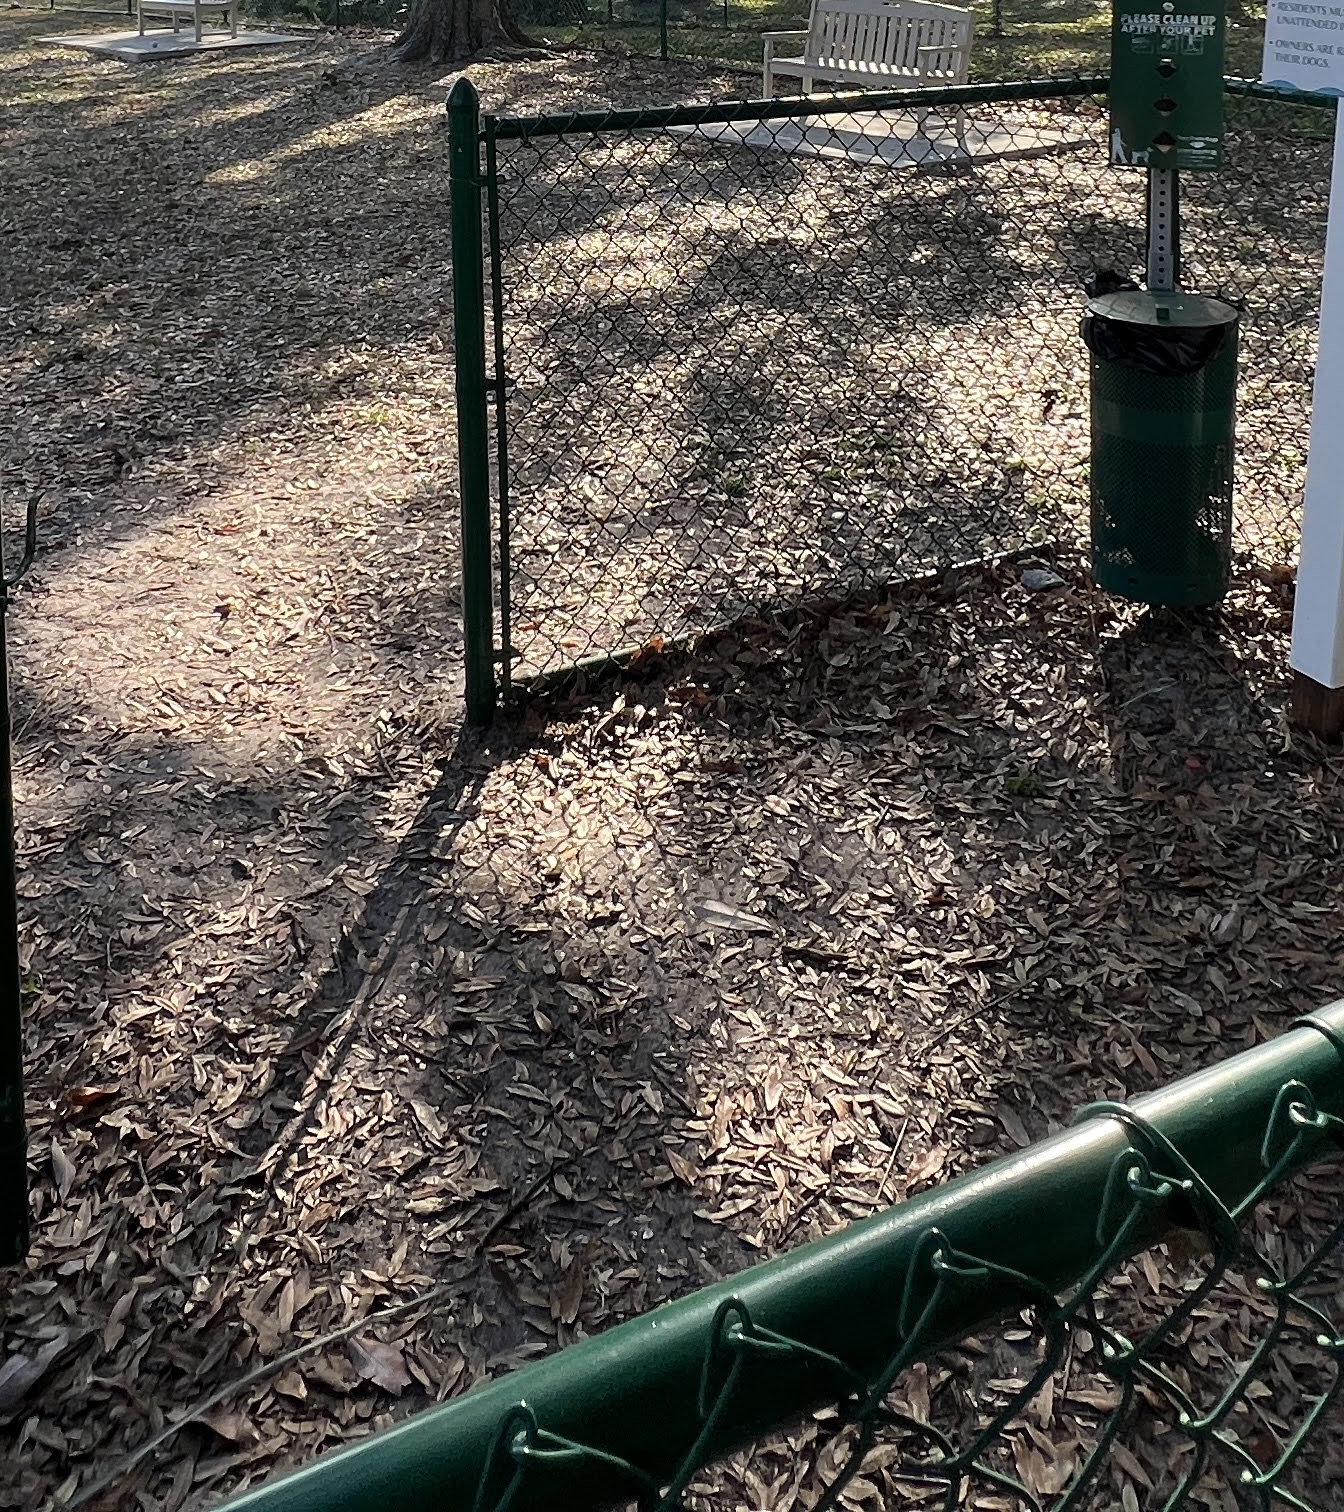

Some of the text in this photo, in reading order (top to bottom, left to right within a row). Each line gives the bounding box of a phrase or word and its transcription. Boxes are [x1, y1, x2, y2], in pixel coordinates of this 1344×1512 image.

[1278, 2, 1326, 15] RESIDENTS
[1121, 14, 1216, 25] PLEASE CLEAN UP
[1277, 16, 1338, 30] UNATTENDED
[1121, 24, 1215, 36] AFTER YOUR PET
[1275, 40, 1314, 52] OWNERS
[1317, 45, 1335, 55] ARE
[1275, 53, 1300, 64] THEIR
